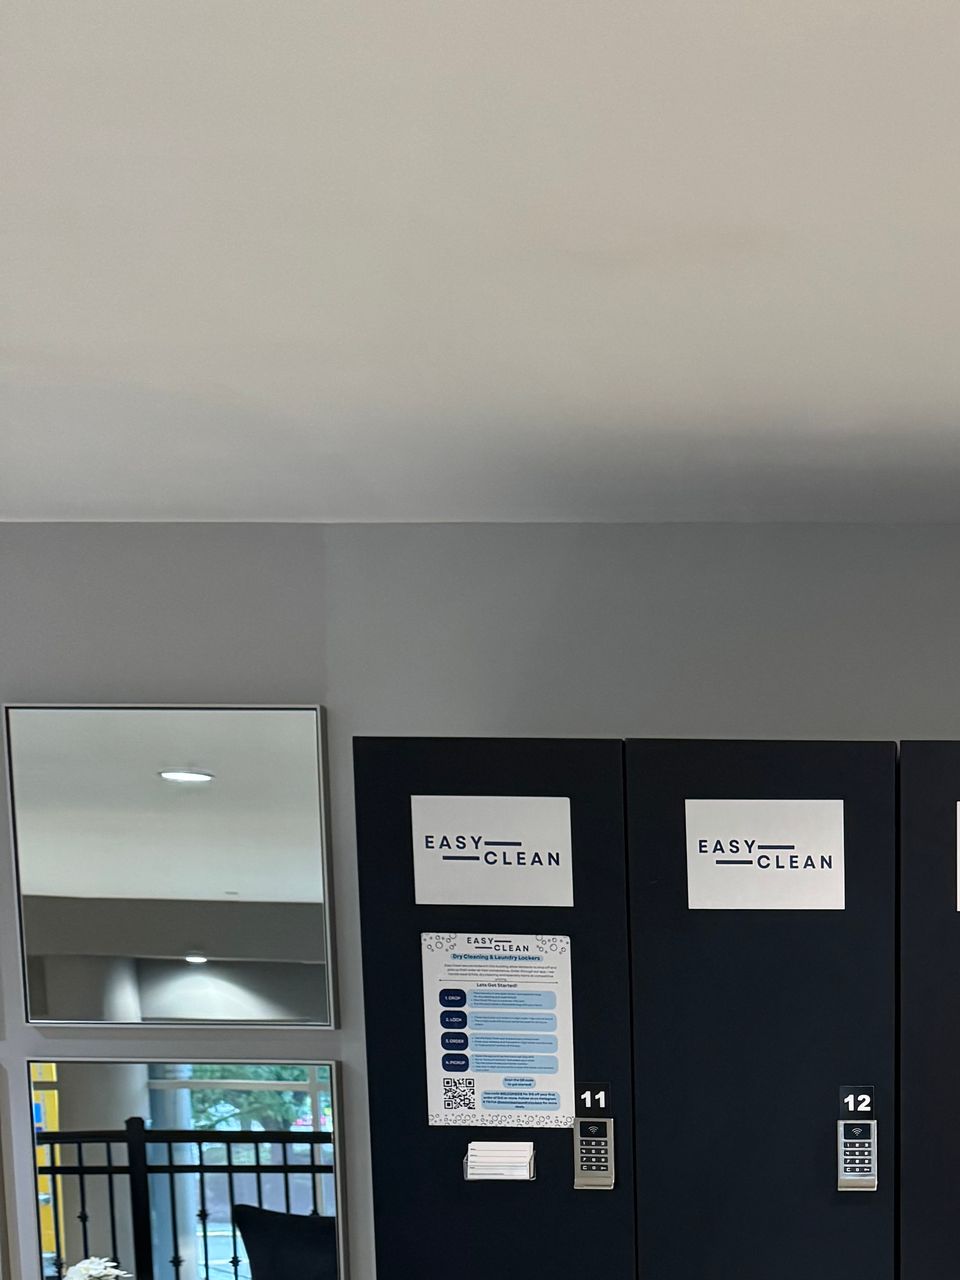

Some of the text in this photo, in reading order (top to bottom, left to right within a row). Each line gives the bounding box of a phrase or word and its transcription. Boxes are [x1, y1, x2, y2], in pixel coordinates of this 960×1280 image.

[424, 835, 483, 849] EASY
[699, 839, 756, 854] EASY
[483, 850, 560, 866] CLEAN
[757, 854, 833, 869] CLEAN
[494, 944, 529, 952] CLEAN
[581, 1091, 606, 1108] 11
[844, 1094, 871, 1111] 12
